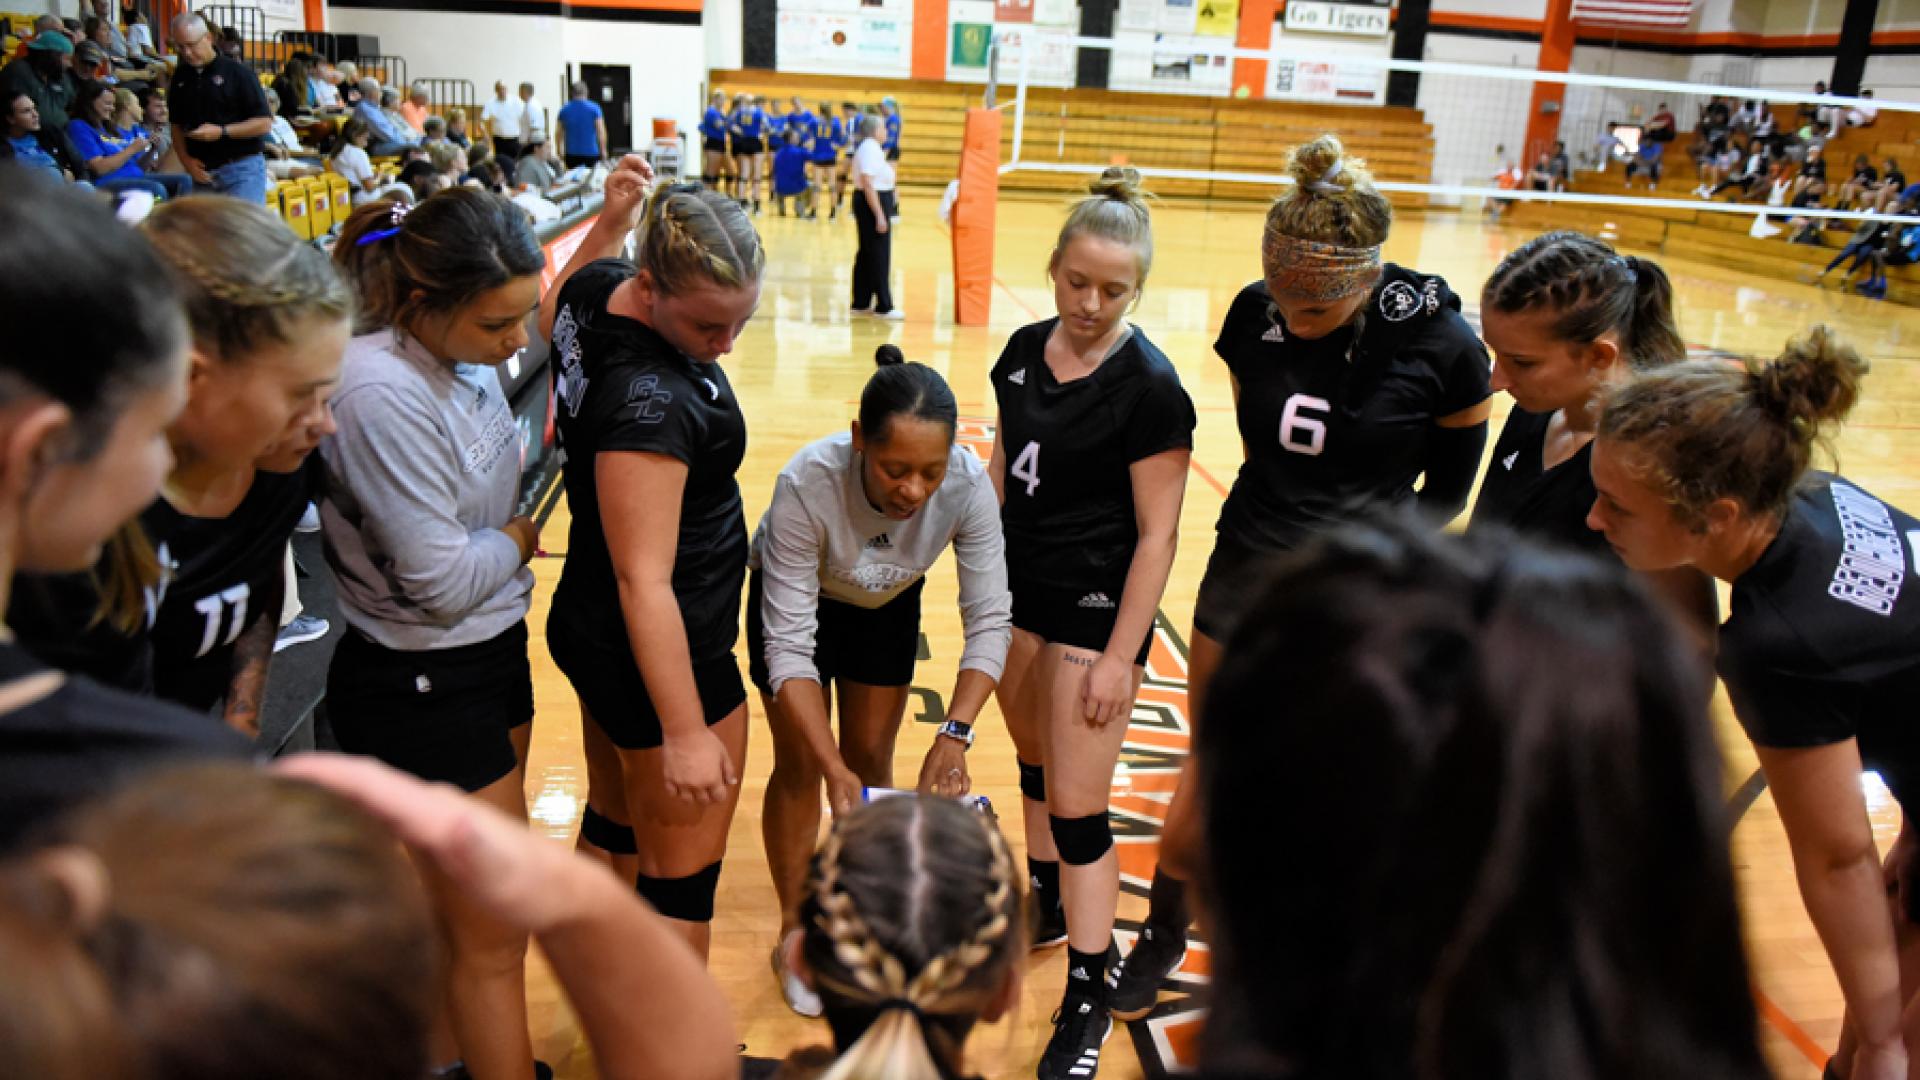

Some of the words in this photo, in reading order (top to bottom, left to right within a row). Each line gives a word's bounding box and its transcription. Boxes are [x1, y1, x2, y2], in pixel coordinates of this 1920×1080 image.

[1290, 6, 1318, 22] Go
[1325, 7, 1385, 29] Tigers
[1279, 392, 1331, 456] 6
[1011, 440, 1041, 497] 4
